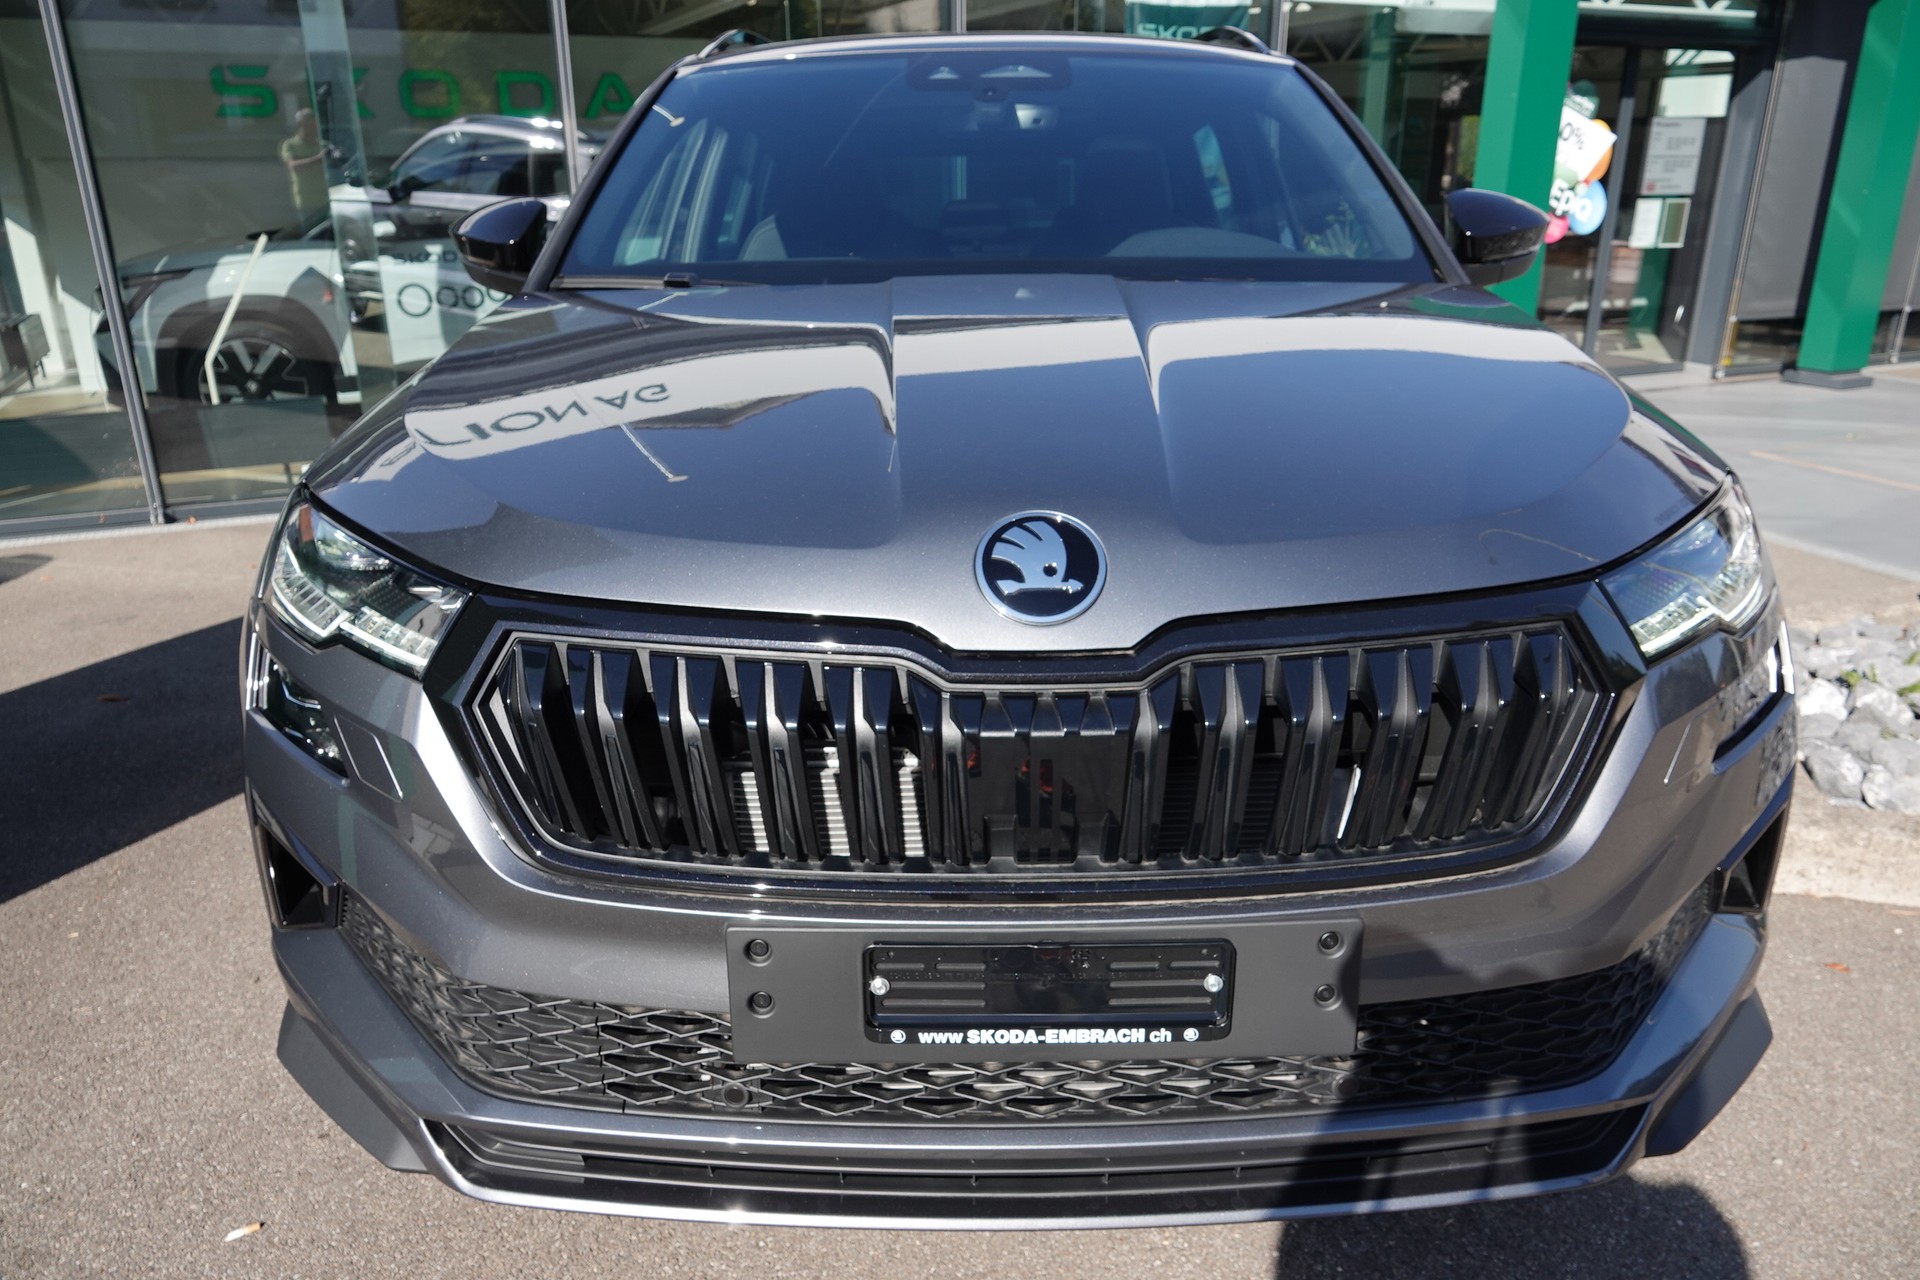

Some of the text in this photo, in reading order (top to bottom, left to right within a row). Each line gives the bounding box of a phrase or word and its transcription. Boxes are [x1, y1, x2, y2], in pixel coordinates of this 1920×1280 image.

[1137, 23, 1217, 40] SKO
[918, 1028, 1172, 1044] www SKODA-EMBRACH ch
